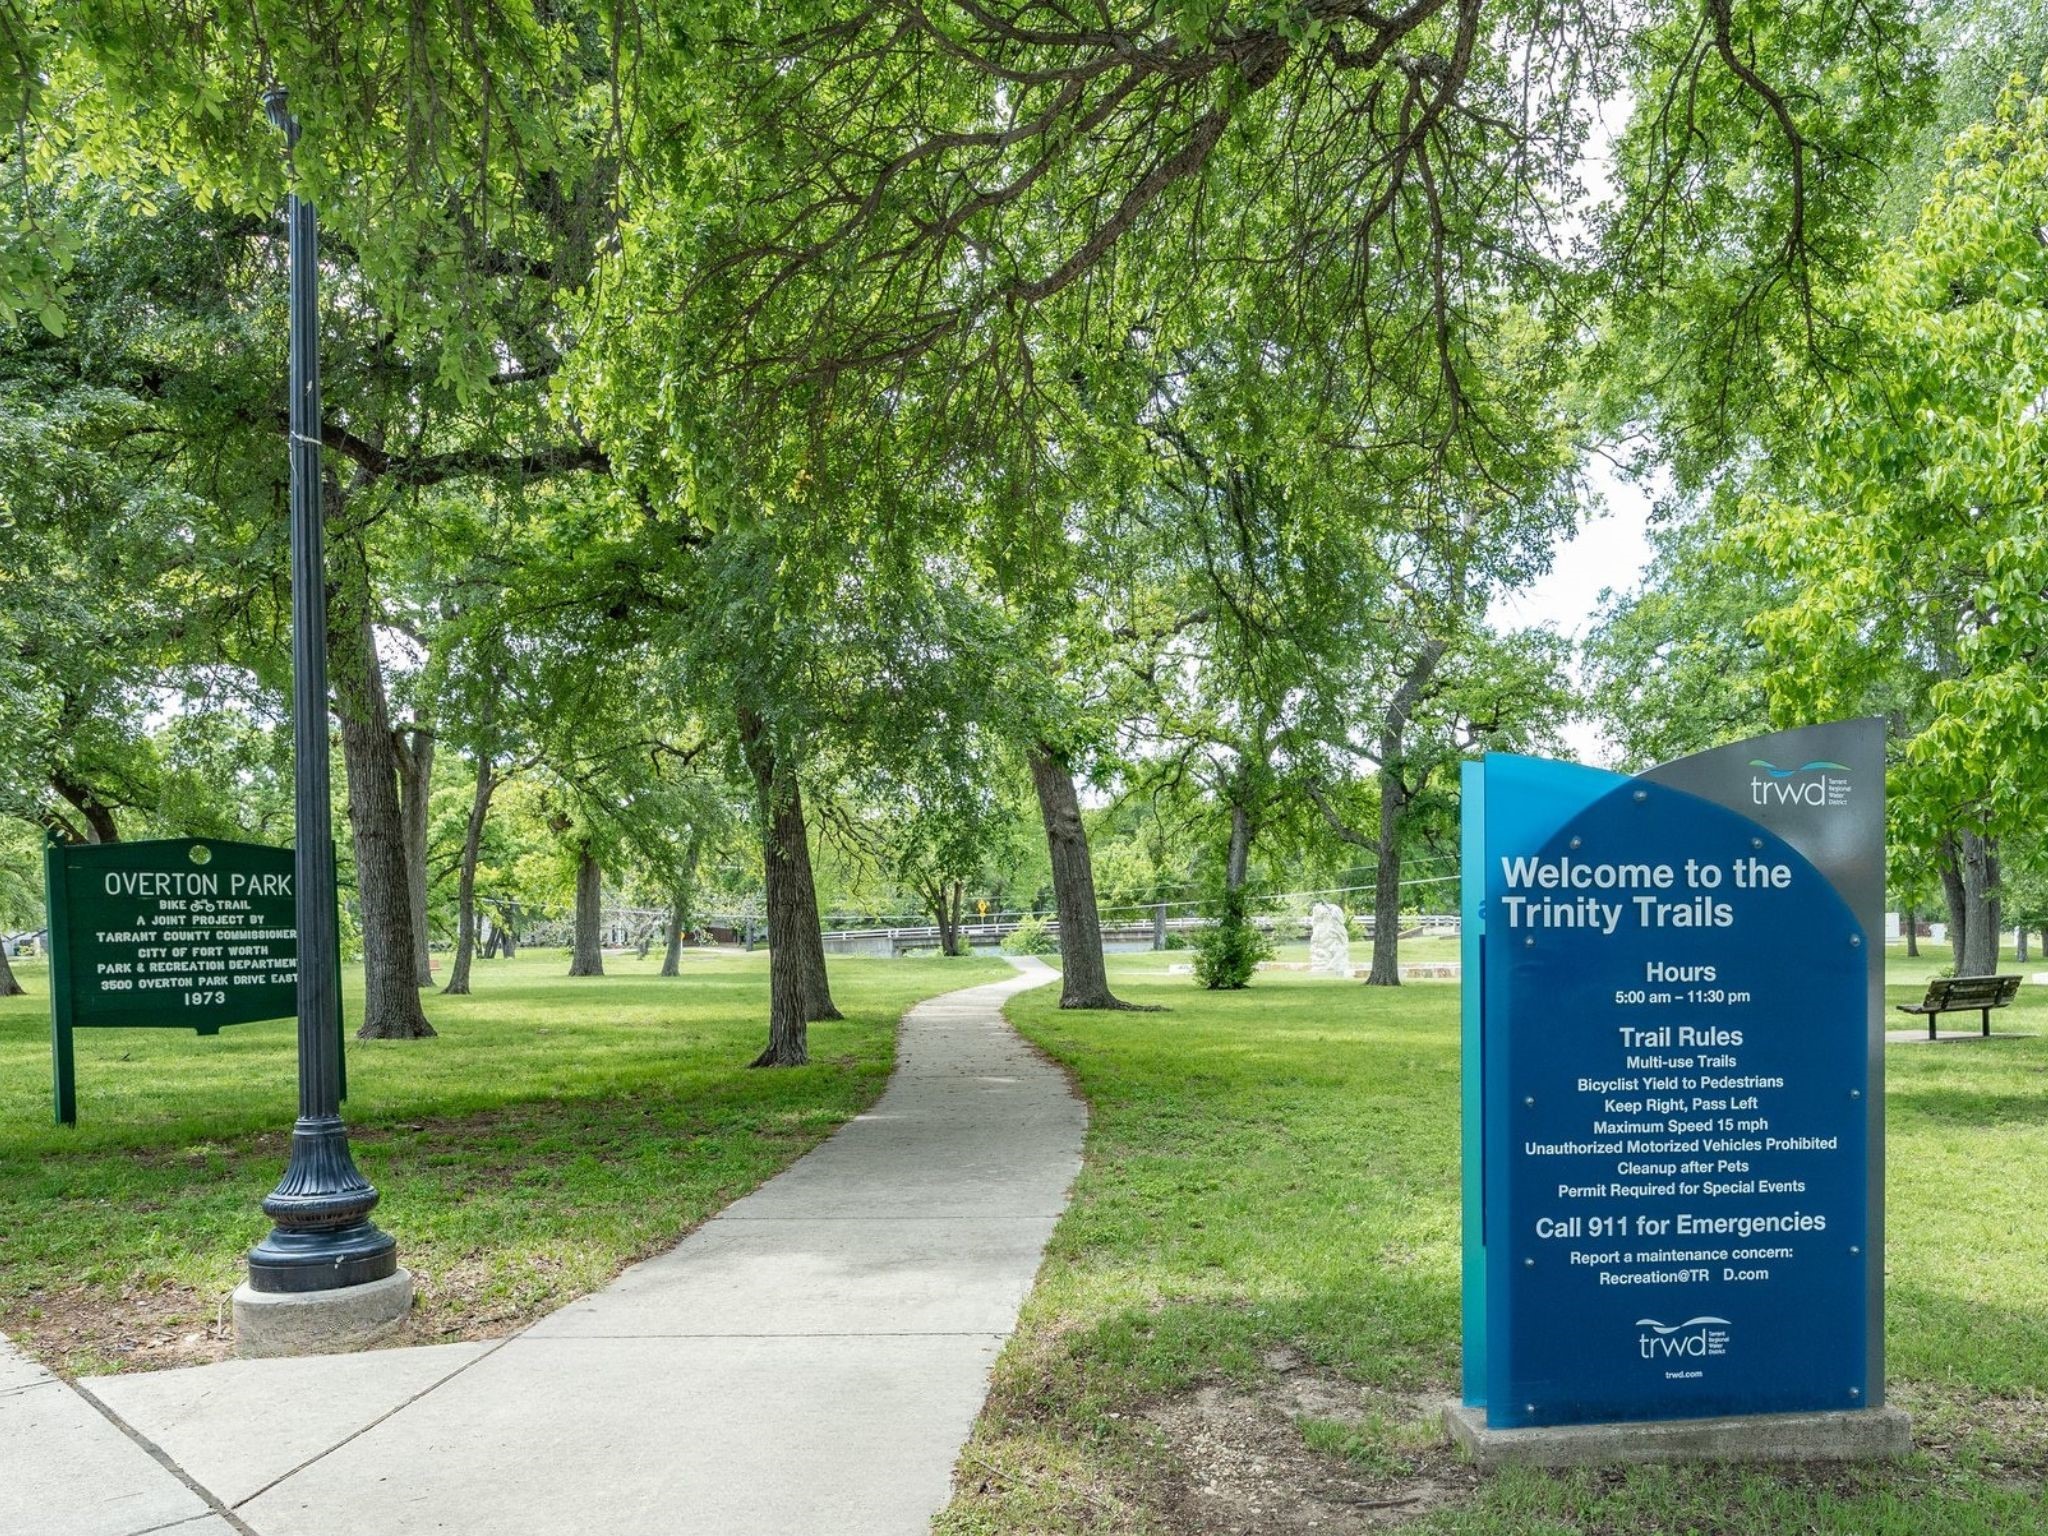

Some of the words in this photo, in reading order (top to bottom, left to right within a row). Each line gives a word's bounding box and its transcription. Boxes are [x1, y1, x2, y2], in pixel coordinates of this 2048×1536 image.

[1750, 774, 1826, 806] trwd
[1501, 857, 1674, 888] Welcome
[1685, 859, 1722, 888] to
[1733, 857, 1792, 888] the
[105, 872, 217, 896] OVERTON
[231, 873, 292, 896] PARK
[159, 899, 187, 910] BIKE
[216, 899, 252, 910] TRAIL
[136, 915, 146, 926] A
[151, 915, 187, 926] JOINT
[192, 914, 245, 925] PROJECT
[249, 914, 265, 925] BY
[1502, 896, 1623, 934] Trinity
[1633, 896, 1734, 927] Trails
[96, 931, 157, 943] TARRANT
[163, 930, 211, 941] COUNTY
[215, 929, 298, 941] COMMISSIONER
[138, 947, 167, 958] CITY
[171, 947, 188, 957] OF
[192, 946, 223, 957] FORT
[228, 945, 269, 957] WORTH
[97, 963, 132, 974] PARK
[136, 962, 145, 973] &
[149, 960, 225, 972] RECREATION
[1646, 961, 1717, 982] Hours
[101, 979, 133, 990] 3500
[138, 977, 193, 989] OVERTON
[198, 976, 229, 987] PARK
[233, 974, 266, 985] DRIVE
[184, 991, 226, 1006] 1973
[1615, 990, 1646, 1004] 5:00
[1649, 993, 1672, 1004] am
[1687, 989, 1725, 1003] 11:30
[1728, 992, 1751, 1006] pm
[1619, 1027, 1671, 1048] Trail
[1679, 1026, 1743, 1047] Rules
[1626, 1055, 1694, 1069] Multi-use
[1697, 1054, 1737, 1068] Trails
[1578, 1077, 1639, 1094] Bicyclist
[1642, 1076, 1678, 1090] Yield
[1681, 1077, 1697, 1090] to
[1700, 1075, 1784, 1089] Pedestrians
[1604, 1099, 1642, 1115] Keep
[1646, 1098, 1688, 1114] Right,
[1692, 1097, 1727, 1111] Pass
[1730, 1096, 1758, 1110] Left
[1593, 1120, 1664, 1134] Maximum
[1667, 1118, 1713, 1135] Speed
[1717, 1118, 1734, 1131] 15
[1737, 1117, 1769, 1134] mph
[1525, 1140, 1623, 1155] Unauthorized
[1627, 1139, 1699, 1153] Motorized
[1702, 1138, 1762, 1152] Vehicles
[1765, 1136, 1837, 1151] Prohibited
[1617, 1161, 1677, 1177] Cleanup
[1680, 1160, 1715, 1174] after
[1717, 1159, 1749, 1173] Pets
[1558, 1183, 1607, 1198] Permit
[1610, 1182, 1676, 1199] Required
[1678, 1181, 1700, 1195] for
[1702, 1180, 1755, 1197] Special
[1758, 1179, 1806, 1193] Events
[1536, 1217, 1581, 1239] Call
[1588, 1216, 1627, 1237] 911
[1635, 1215, 1670, 1235] for
[1677, 1212, 1826, 1238] Emergencies
[1570, 1250, 1620, 1266] Report
[1624, 1252, 1633, 1263] a
[1636, 1249, 1729, 1262] maintenance
[1731, 1247, 1793, 1260] concern:
[1639, 1328, 1706, 1359] trwd
[1664, 1370, 1703, 1379] trwd.com
